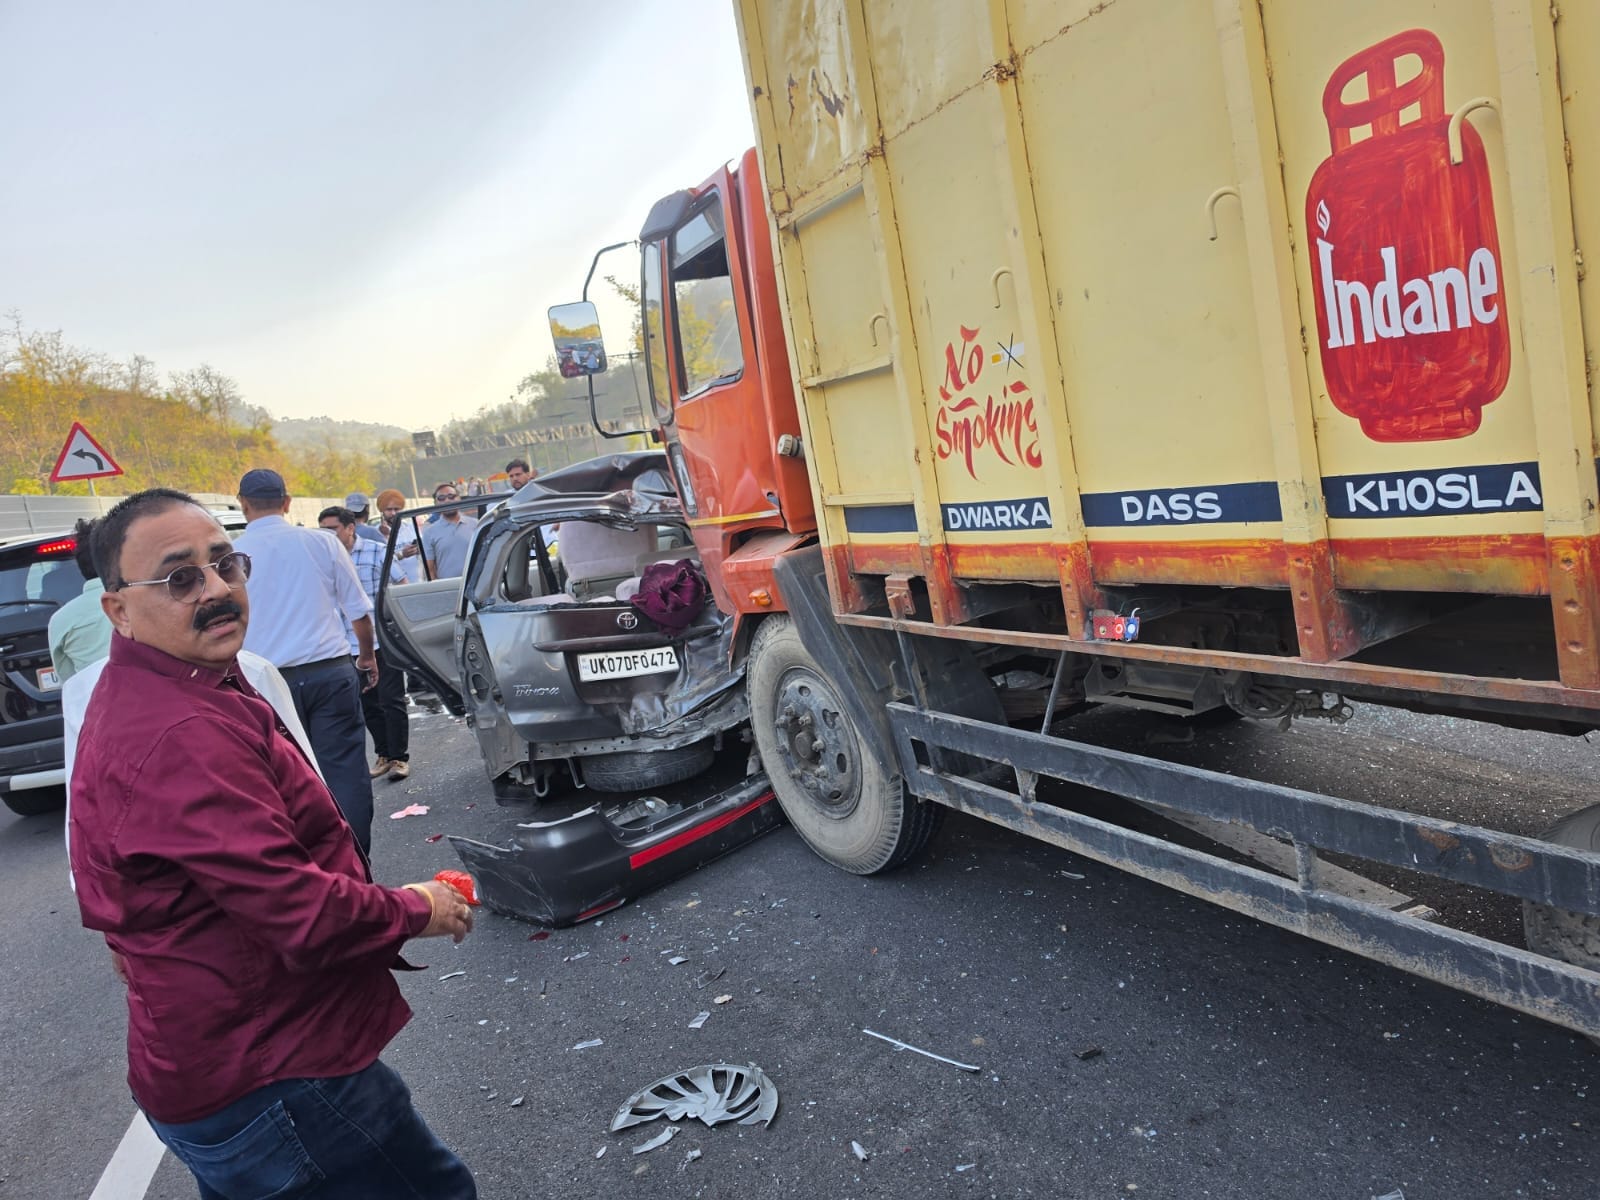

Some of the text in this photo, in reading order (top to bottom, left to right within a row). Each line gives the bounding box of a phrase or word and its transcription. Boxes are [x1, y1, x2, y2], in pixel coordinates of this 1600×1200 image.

[1316, 237, 1498, 349] Indane
[939, 325, 984, 401] No
[947, 471, 1541, 528] DWARKA DASS KHOSLA
[590, 651, 676, 674] UK07DF0472
